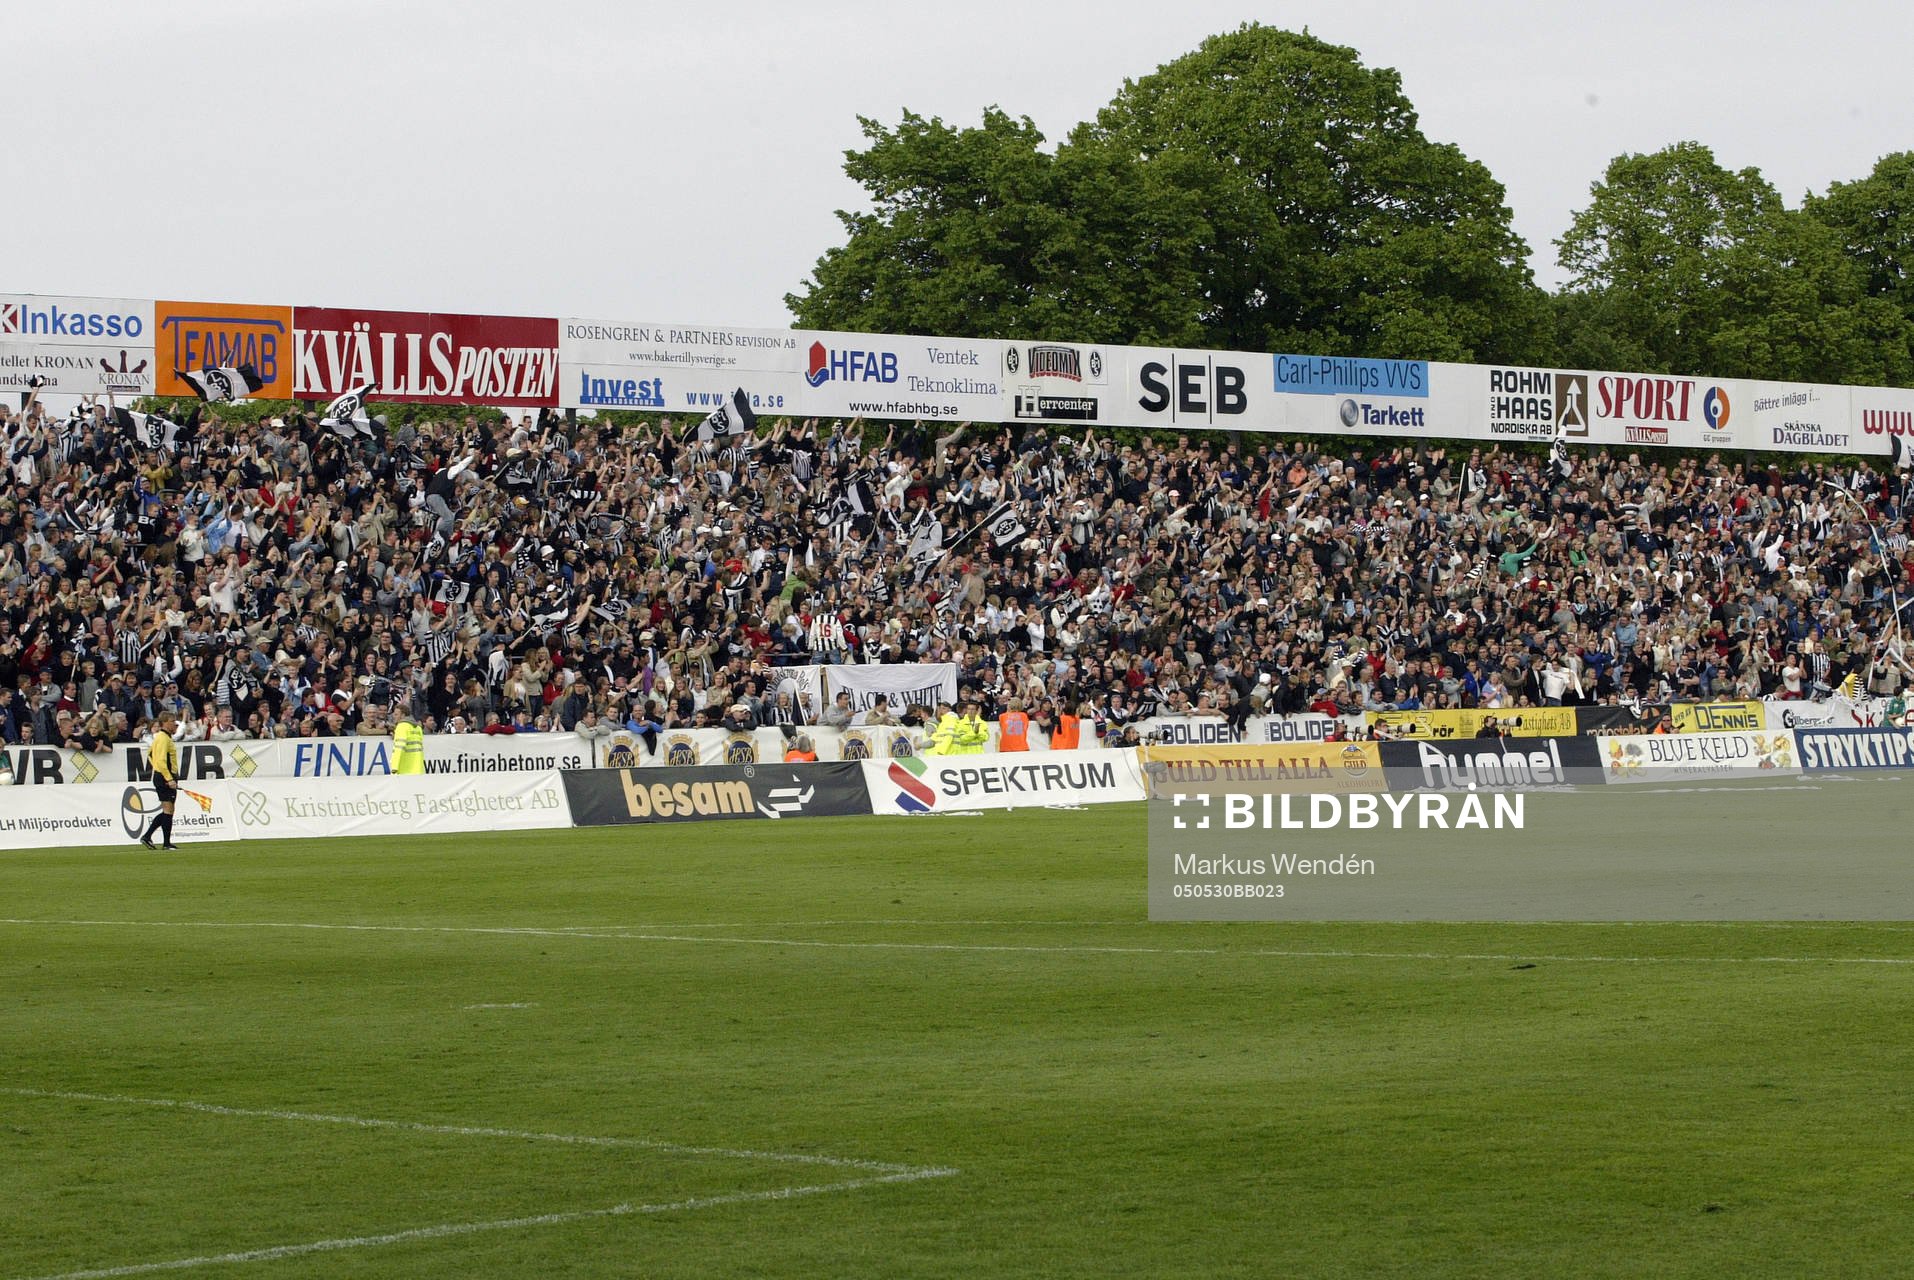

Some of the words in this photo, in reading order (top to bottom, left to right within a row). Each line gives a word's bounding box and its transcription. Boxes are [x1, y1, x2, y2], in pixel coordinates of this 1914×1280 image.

[567, 325, 650, 346] ROSENGREN
[654, 331, 665, 347] &
[669, 332, 735, 349] PARTNERS
[735, 337, 782, 353] REVISION
[784, 340, 797, 353] AB
[34, 355, 94, 373] KRONAN
[629, 352, 737, 371] www.bakertillysverige.se
[830, 350, 899, 383] HFAB
[928, 348, 979, 365] Ventek
[1028, 346, 1082, 377] VIDEOMIX
[99, 373, 150, 385] KRONAN
[582, 368, 663, 400] Invest
[1277, 357, 1379, 393] Carl-Philips
[1386, 364, 1422, 392] VVS
[1490, 369, 1553, 395] ROHM
[908, 377, 998, 396] Teknoklima
[849, 400, 959, 416] www.hfabhbg.se
[1018, 385, 1094, 418] Herrcenter
[1496, 396, 1554, 421] HAAS
[1596, 376, 1696, 423] SPORT
[1754, 396, 1780, 413] Bättre
[1782, 391, 1807, 408] inlägg
[1361, 402, 1424, 430] Tarkett
[1491, 422, 1537, 436] NORDISKA
[1540, 424, 1552, 435] AB
[1773, 428, 1849, 450] DAGBLADET
[1784, 422, 1821, 435] SKÅNSKA
[819, 623, 831, 638] 16
[888, 692, 899, 709] &
[1161, 723, 1241, 745] BOLIDEN
[1432, 724, 1454, 738] rör
[1418, 739, 1564, 786] hummel
[1649, 741, 1696, 766] BLUE
[1701, 738, 1749, 767] KELD
[1220, 757, 1273, 780] TILL
[1277, 755, 1333, 780] ALLA
[1343, 760, 1367, 769] GULD
[940, 763, 1116, 796] SPEKTRUM
[284, 794, 411, 822] Kristineberg
[415, 787, 524, 819] Fastigheter
[531, 789, 560, 810] AB
[19, 816, 112, 835] Miljöprodukter
